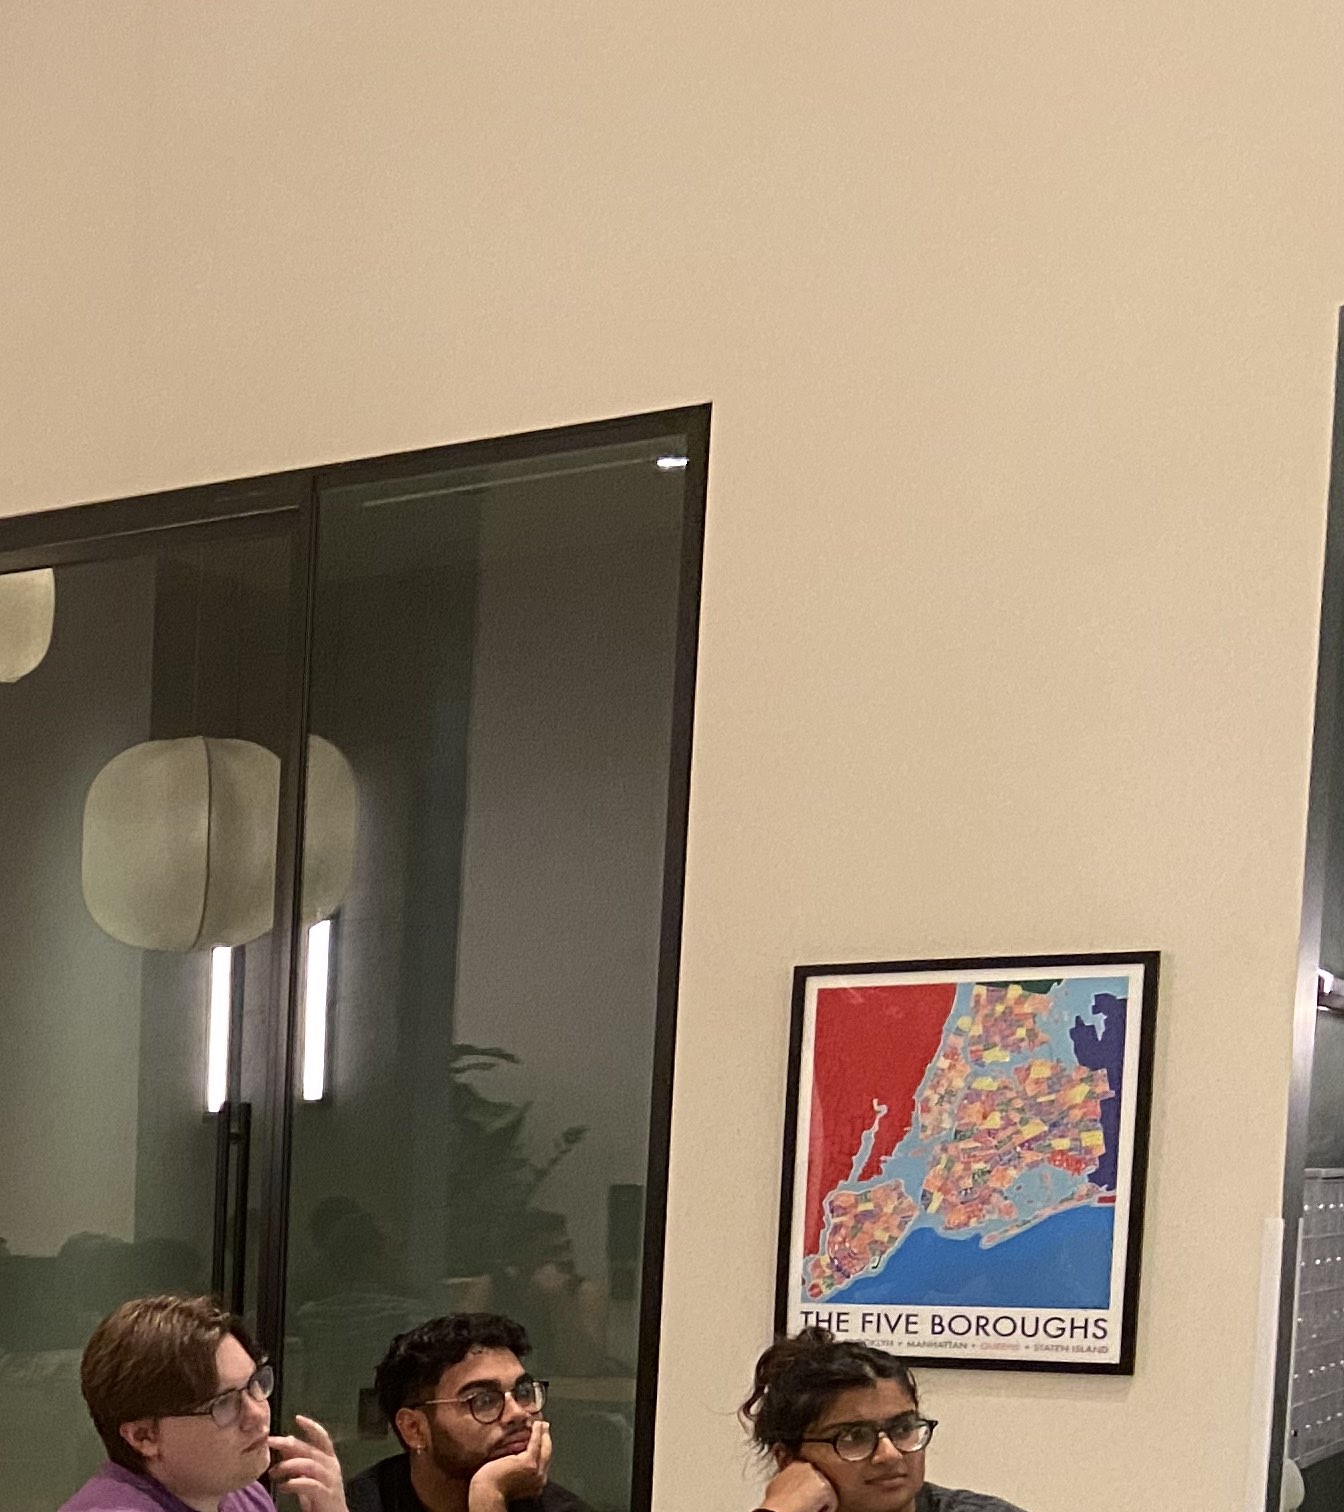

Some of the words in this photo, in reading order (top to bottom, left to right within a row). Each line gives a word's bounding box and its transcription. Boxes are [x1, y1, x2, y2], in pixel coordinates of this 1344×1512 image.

[800, 1310, 850, 1332] THE
[861, 1312, 919, 1335] FIVE
[931, 1314, 1109, 1340] BOROUGHS
[907, 1341, 968, 1349] MANHATTAN
